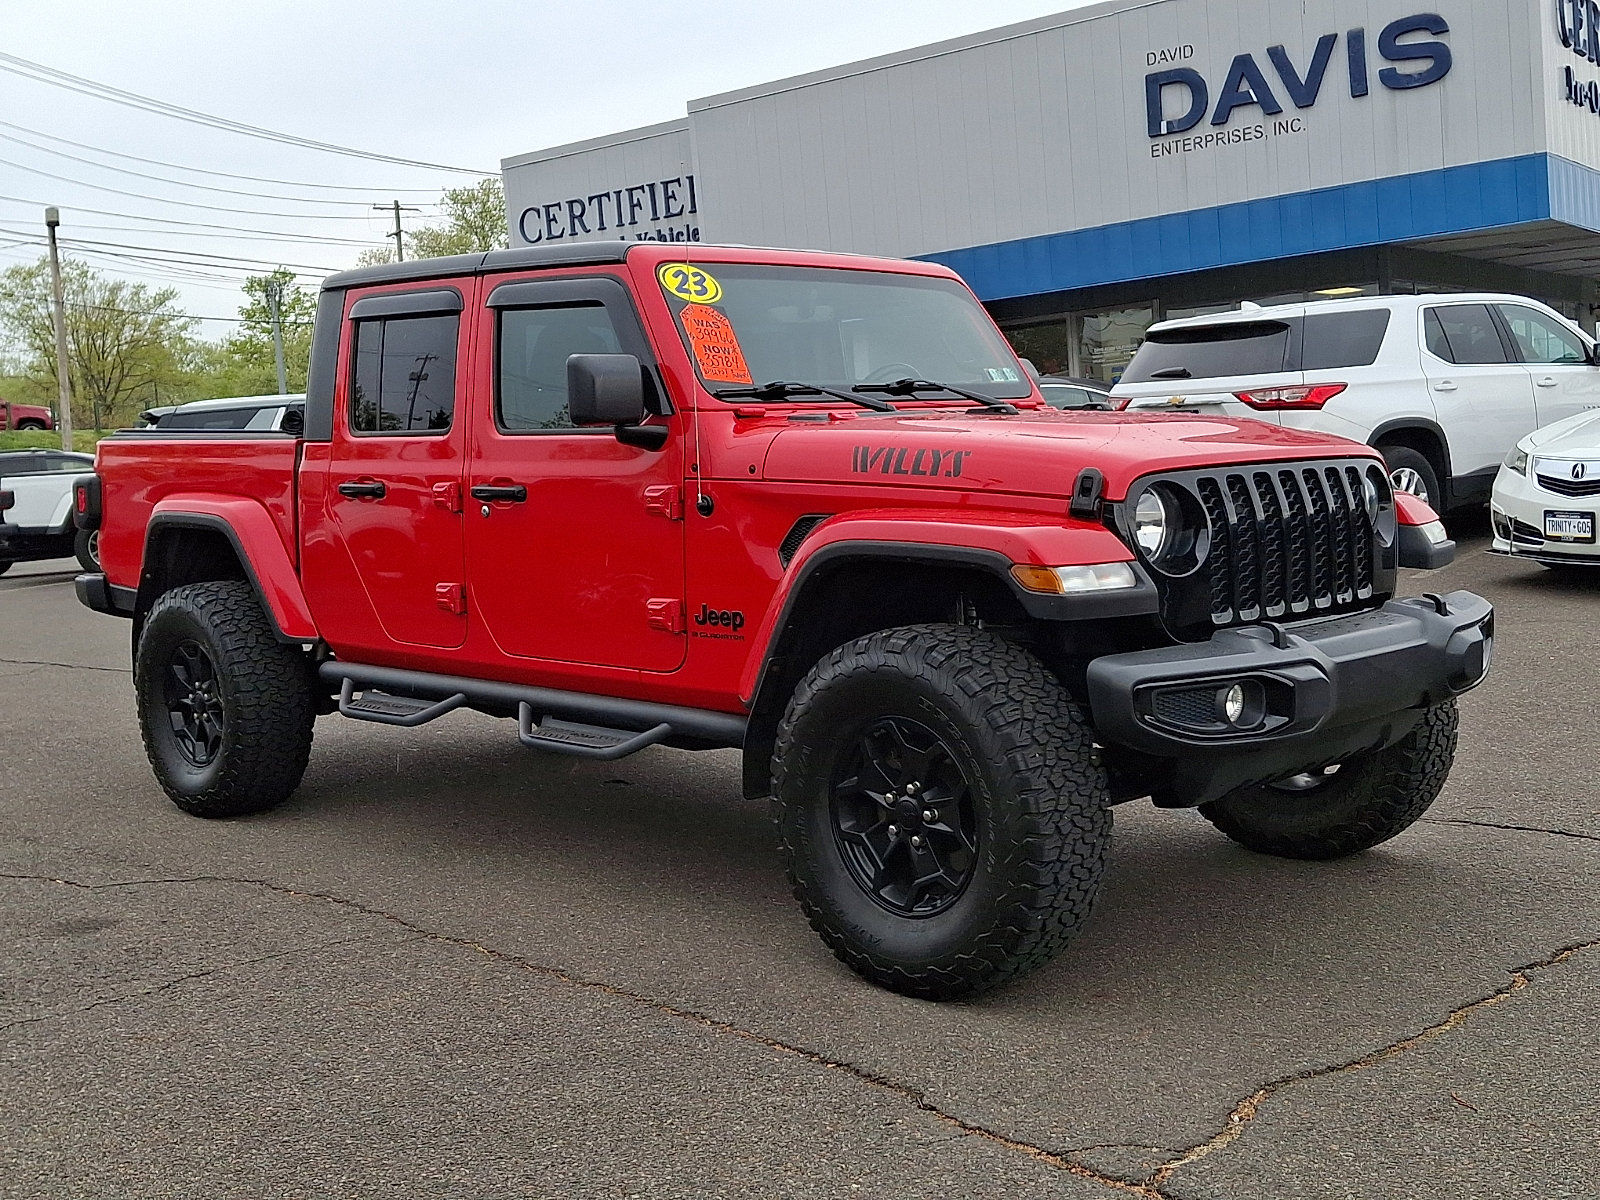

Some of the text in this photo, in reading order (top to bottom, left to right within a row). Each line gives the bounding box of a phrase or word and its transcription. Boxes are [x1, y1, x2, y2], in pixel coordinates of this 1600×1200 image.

[1146, 44, 1194, 66] DAVID
[1144, 12, 1453, 138] DAVIS
[1150, 117, 1306, 158] ENTERPRISES, INC.
[636, 224, 700, 243] Vhicle
[671, 269, 709, 296] 23
[693, 318, 721, 329] WAS
[852, 446, 972, 478] WILLYS
[694, 603, 745, 632] Jeep
